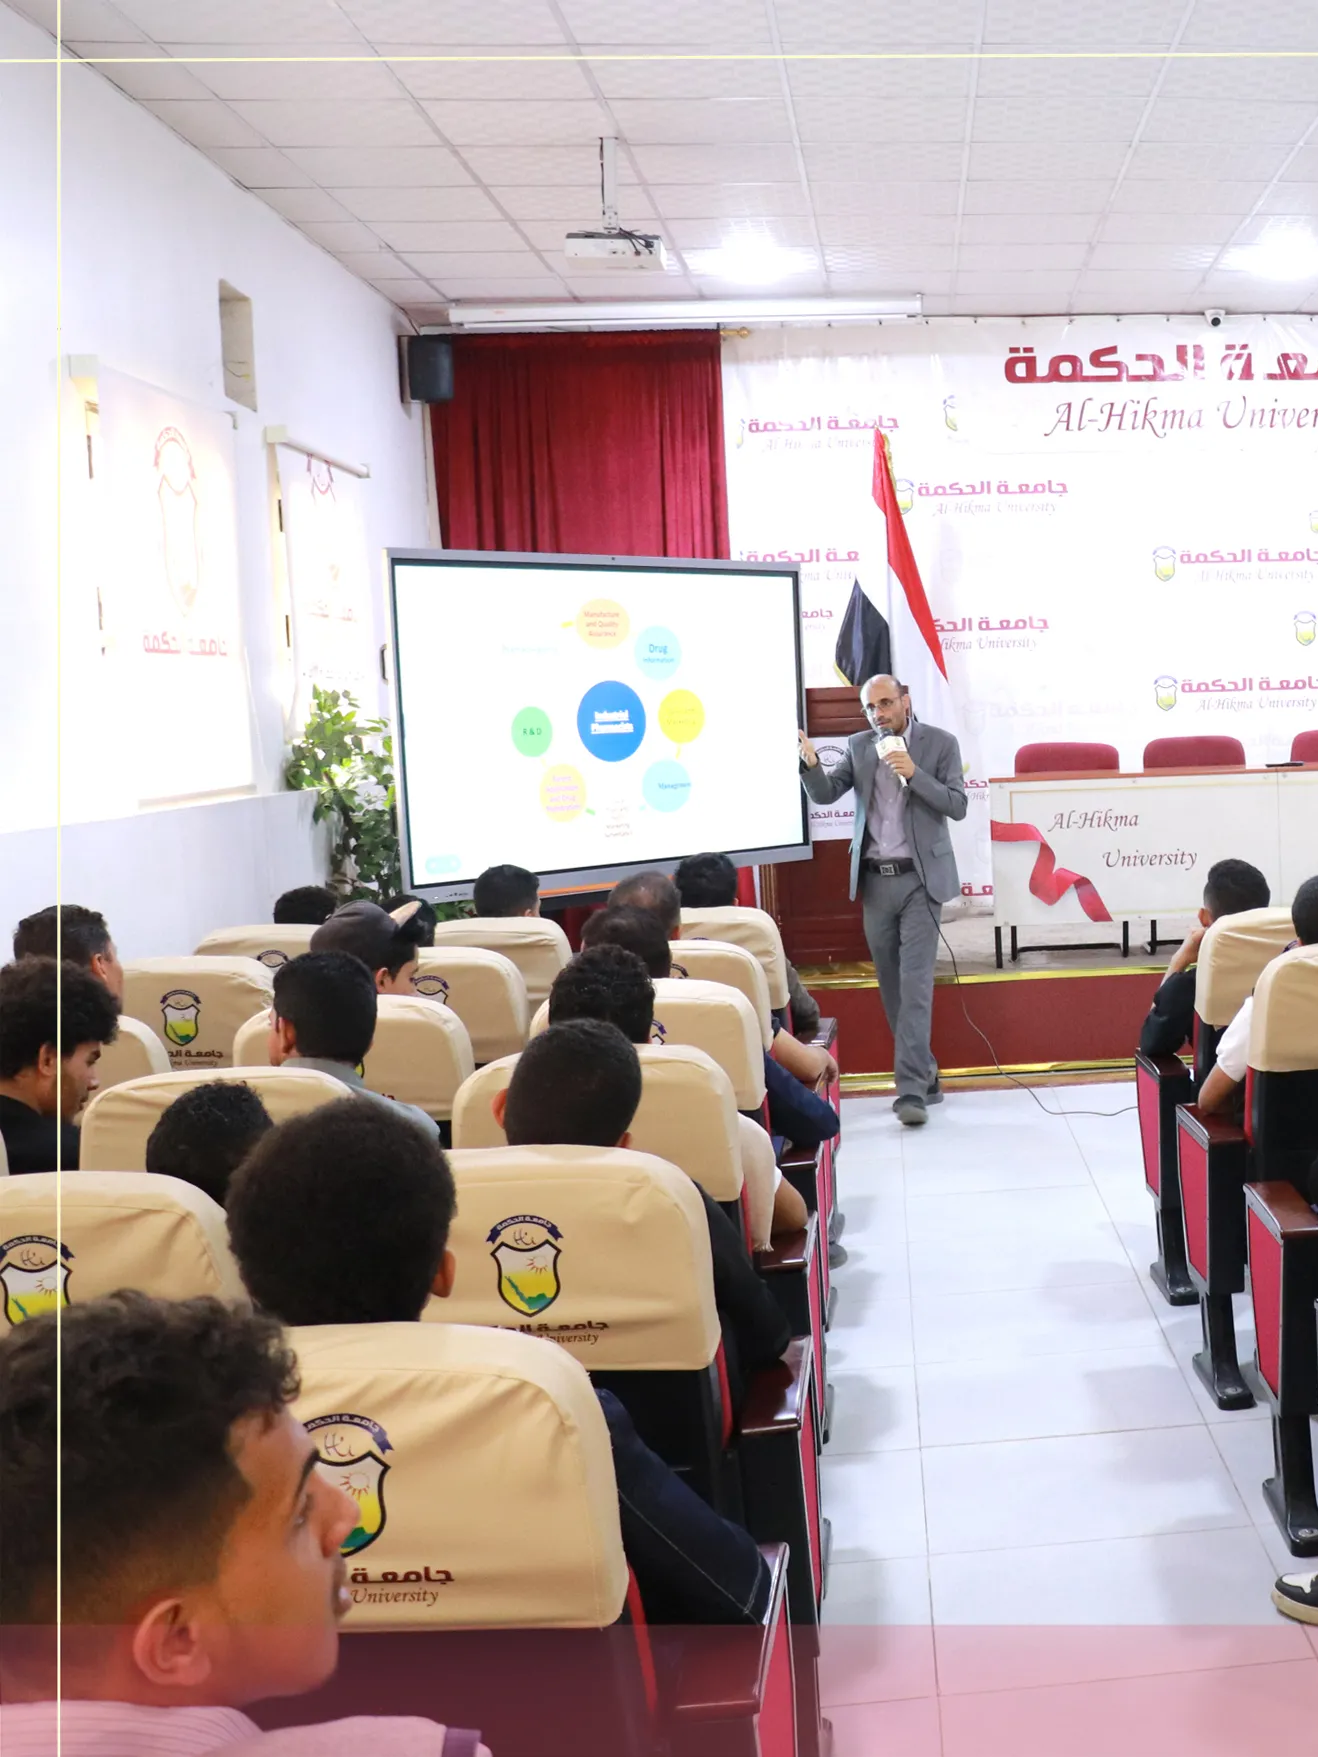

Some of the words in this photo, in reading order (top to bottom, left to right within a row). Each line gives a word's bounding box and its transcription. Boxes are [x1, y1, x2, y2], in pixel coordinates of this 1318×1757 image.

[1003, 344, 1205, 384] الحكمة
[1044, 397, 1203, 439] Al-Hikma
[917, 481, 992, 498] الحكمة
[995, 480, 1069, 498] جامعة
[1180, 548, 1252, 564] الحكمة
[978, 616, 1049, 633] جامعة
[648, 643, 668, 655] Drug
[1181, 677, 1253, 694] الحكمة
[1195, 698, 1254, 713] Al-Hikma
[1258, 696, 1318, 712] University
[1047, 808, 1140, 832] Al-Hikma
[1102, 848, 1198, 871] University
[184, 1050, 225, 1059] جامعة
[537, 1320, 609, 1333] جامعة
[351, 1566, 454, 1585] جامعة
[351, 1588, 438, 1608] University
